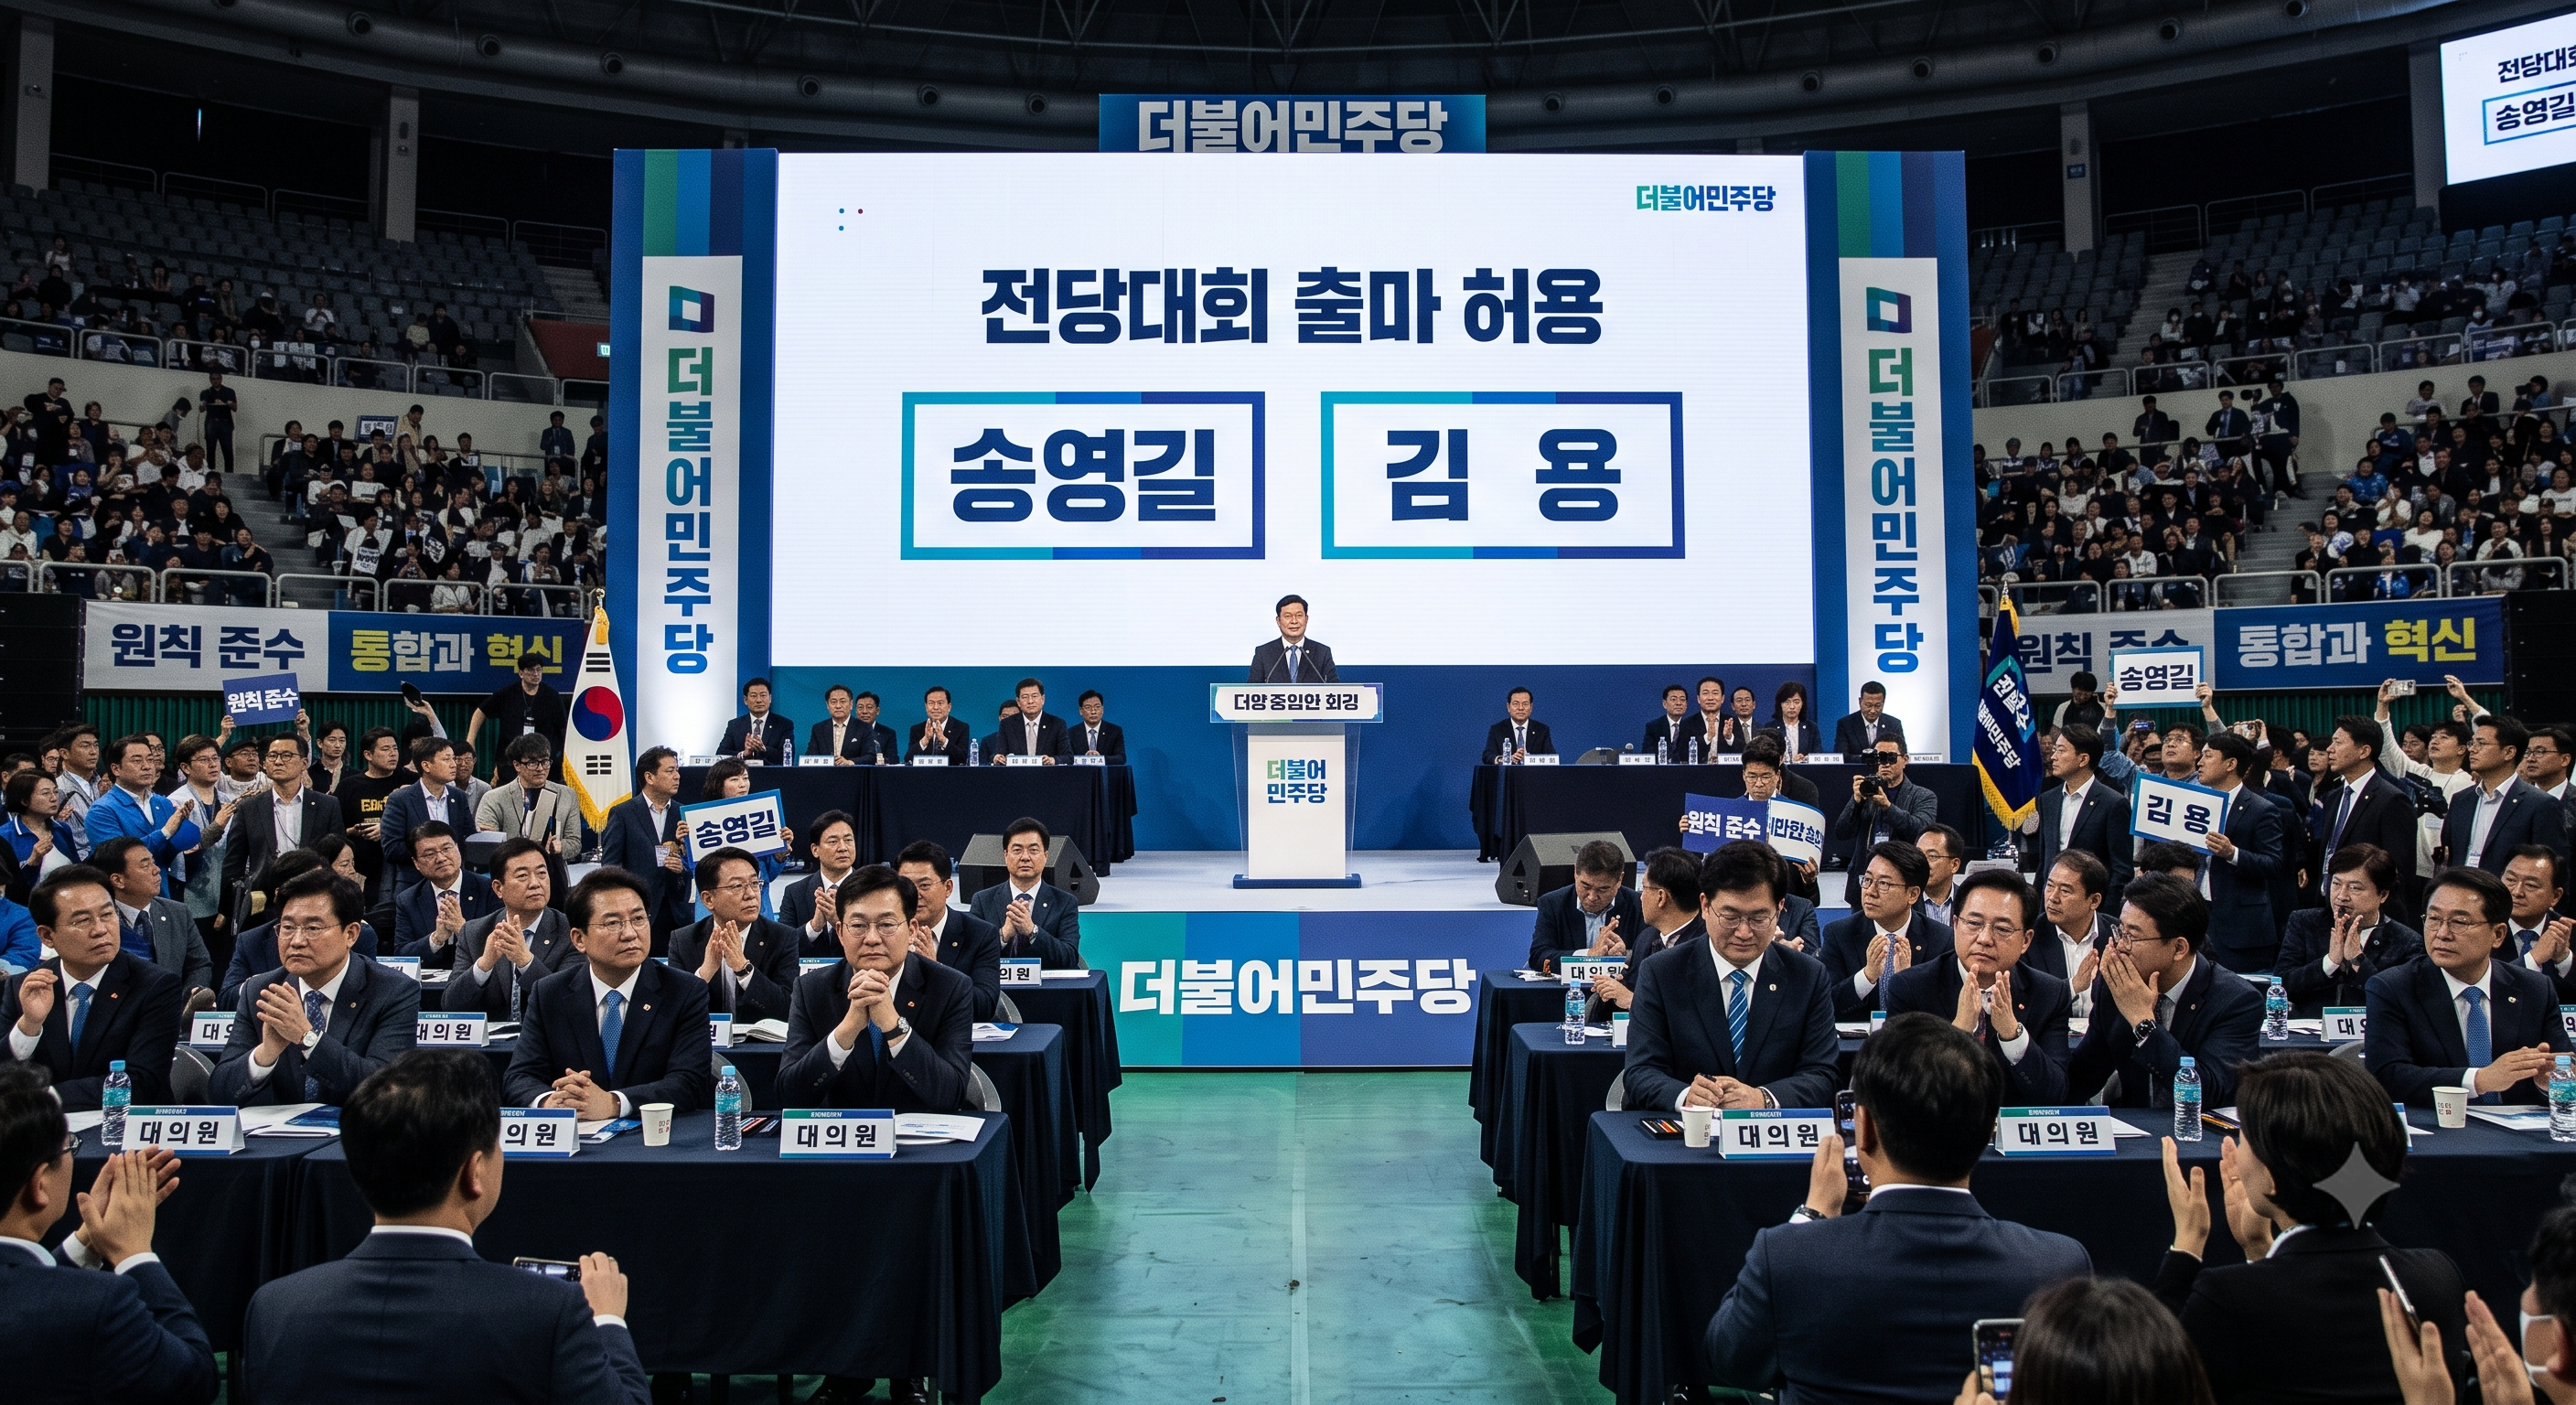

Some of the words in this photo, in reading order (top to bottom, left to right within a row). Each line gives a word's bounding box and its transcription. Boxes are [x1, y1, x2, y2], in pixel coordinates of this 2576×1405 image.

[1139, 101, 1448, 153] 더불어민주당
[2496, 91, 2576, 131] 송영길
[1637, 186, 1776, 211] 더불어민주당
[982, 267, 1267, 344] 전당대회
[1295, 267, 1441, 344] 출마
[1464, 268, 1604, 344] 허용
[951, 429, 1216, 522] 송영길
[664, 347, 714, 674] 더불어민주당
[1869, 348, 1924, 673] 더불어민주당
[112, 624, 202, 669] 원칙
[219, 627, 306, 670] 준수
[351, 629, 475, 672] 통합과
[487, 633, 563, 674] 혁신
[2015, 631, 2093, 674] 원칙
[2238, 622, 2371, 668] 통합과
[2385, 617, 2476, 662] 혁신
[2120, 664, 2195, 692] 송영길
[228, 691, 263, 713] 원칙
[264, 688, 299, 710] 준수
[1268, 759, 1326, 780] 더불어
[1267, 783, 1327, 804] 민주당
[696, 810, 777, 849] 송영길
[1688, 810, 1722, 837] 원칙
[1725, 815, 1761, 840] 준수
[1000, 968, 1030, 981] 의원
[1120, 959, 1476, 1015] 더불어민주당
[140, 1121, 219, 1144] 대의원
[505, 1123, 557, 1146] 의원
[797, 1124, 876, 1148] 대의원
[1738, 1124, 1819, 1148] 대의원
[2018, 1121, 2099, 1145] 대의원
